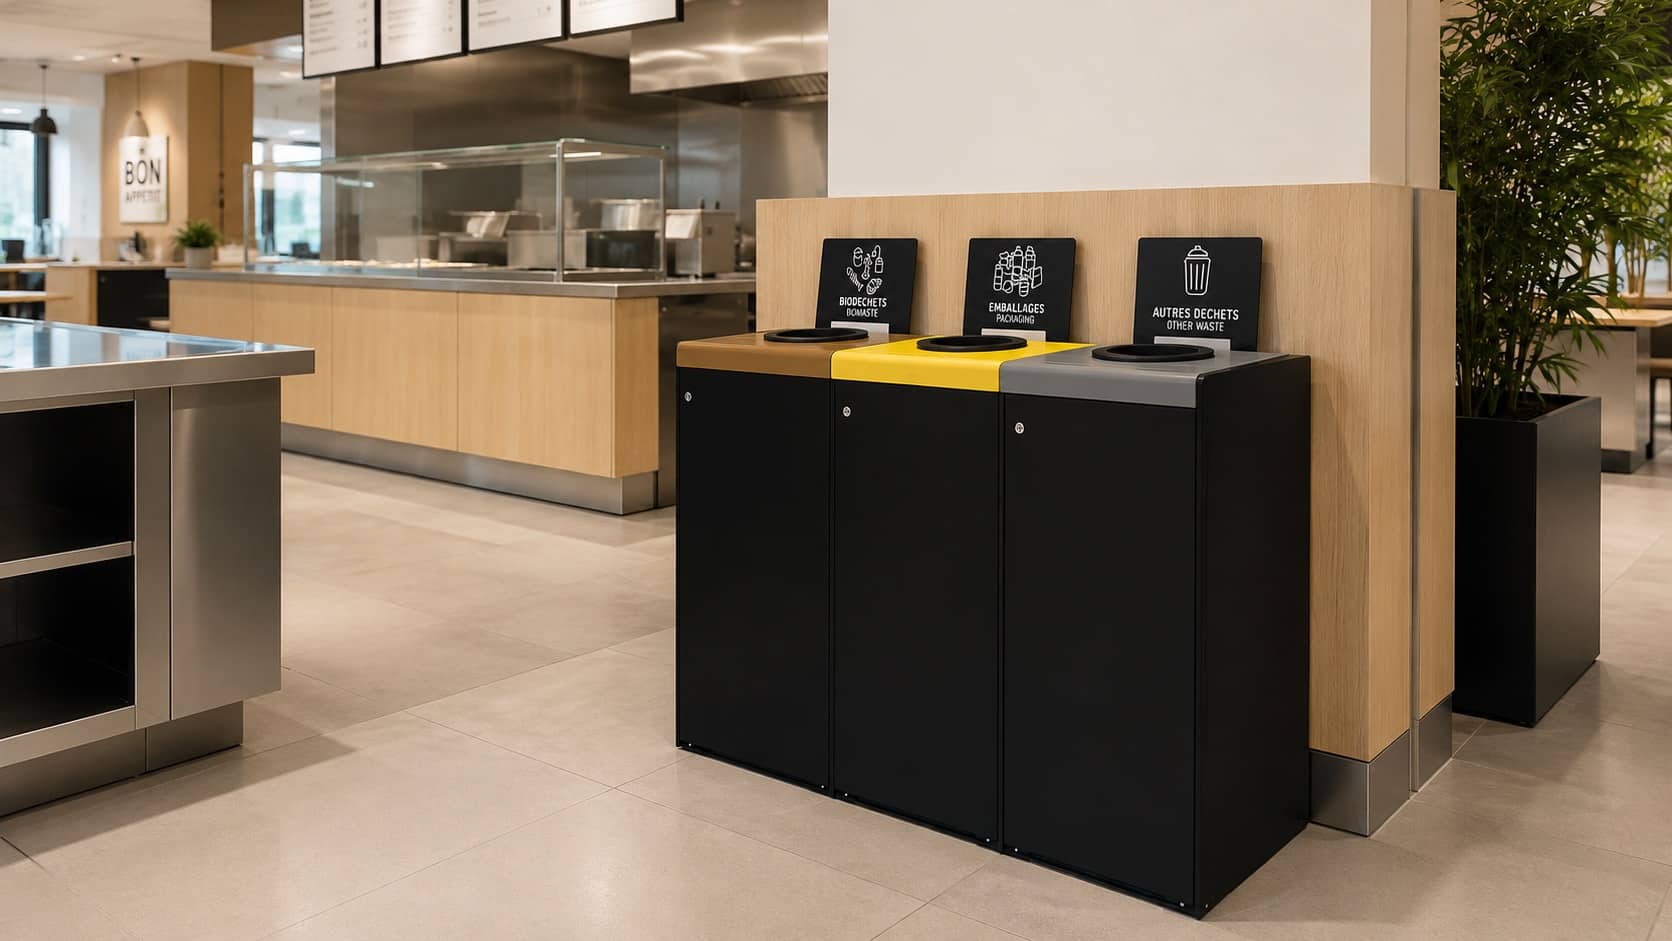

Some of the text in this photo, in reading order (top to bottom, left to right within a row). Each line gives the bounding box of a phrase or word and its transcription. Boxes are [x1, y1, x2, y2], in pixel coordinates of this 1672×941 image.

[125, 159, 161, 185] BON
[839, 296, 888, 308] BIODECHETS
[989, 302, 1045, 314] EMBALLAGES
[1152, 306, 1240, 321] AUTRES DECHETS
[1166, 320, 1225, 332] OTHER WASTE
